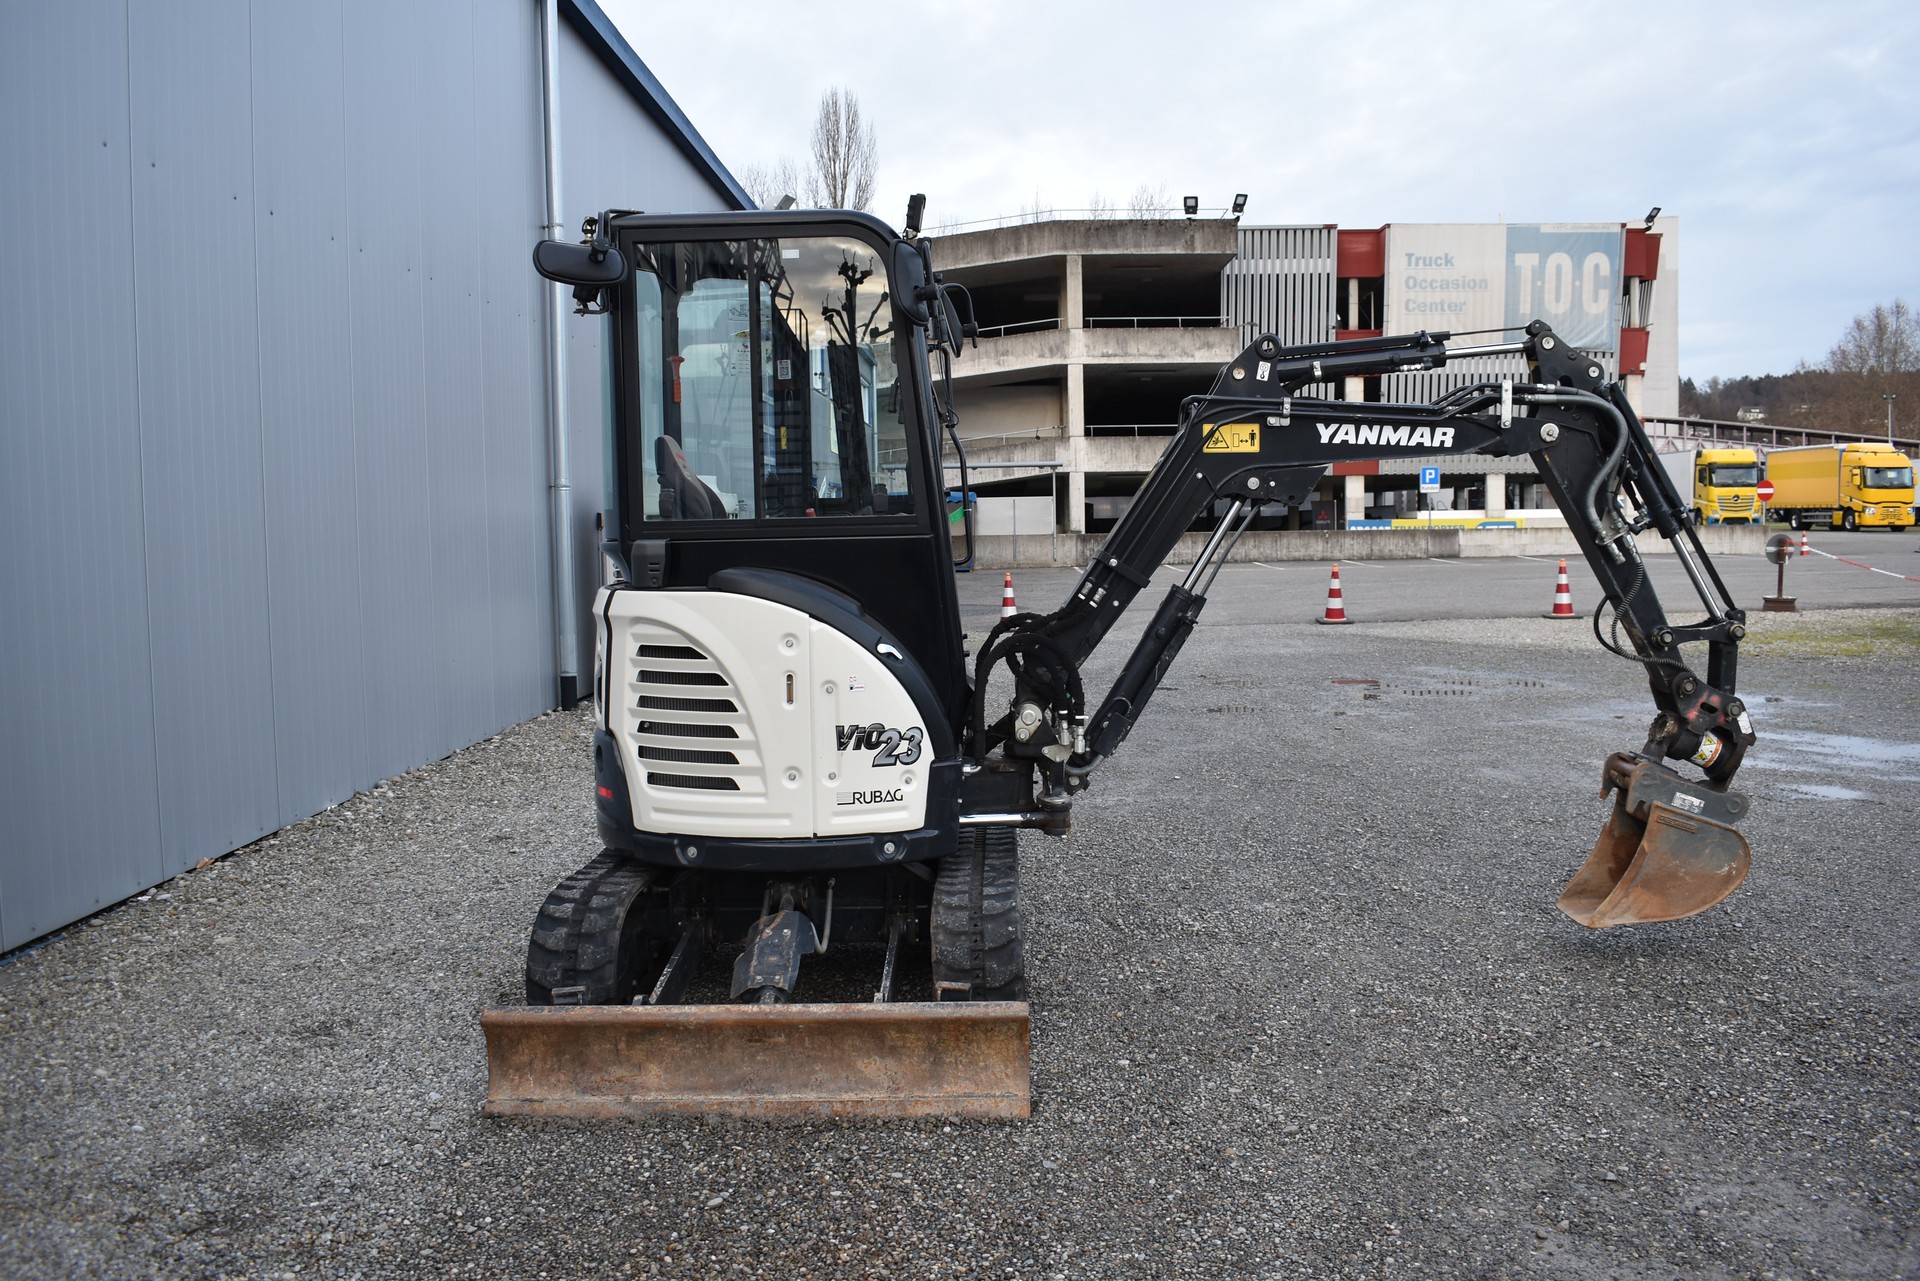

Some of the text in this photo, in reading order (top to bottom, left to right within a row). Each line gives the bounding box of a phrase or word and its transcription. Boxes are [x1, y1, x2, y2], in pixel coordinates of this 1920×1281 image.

[1404, 252, 1455, 268] Truck
[1404, 275, 1489, 290] Occasion
[1404, 298, 1467, 313] Center
[1315, 422, 1456, 448] YANMAR
[1426, 469, 1435, 483] P
[852, 788, 904, 806] RUBAG
